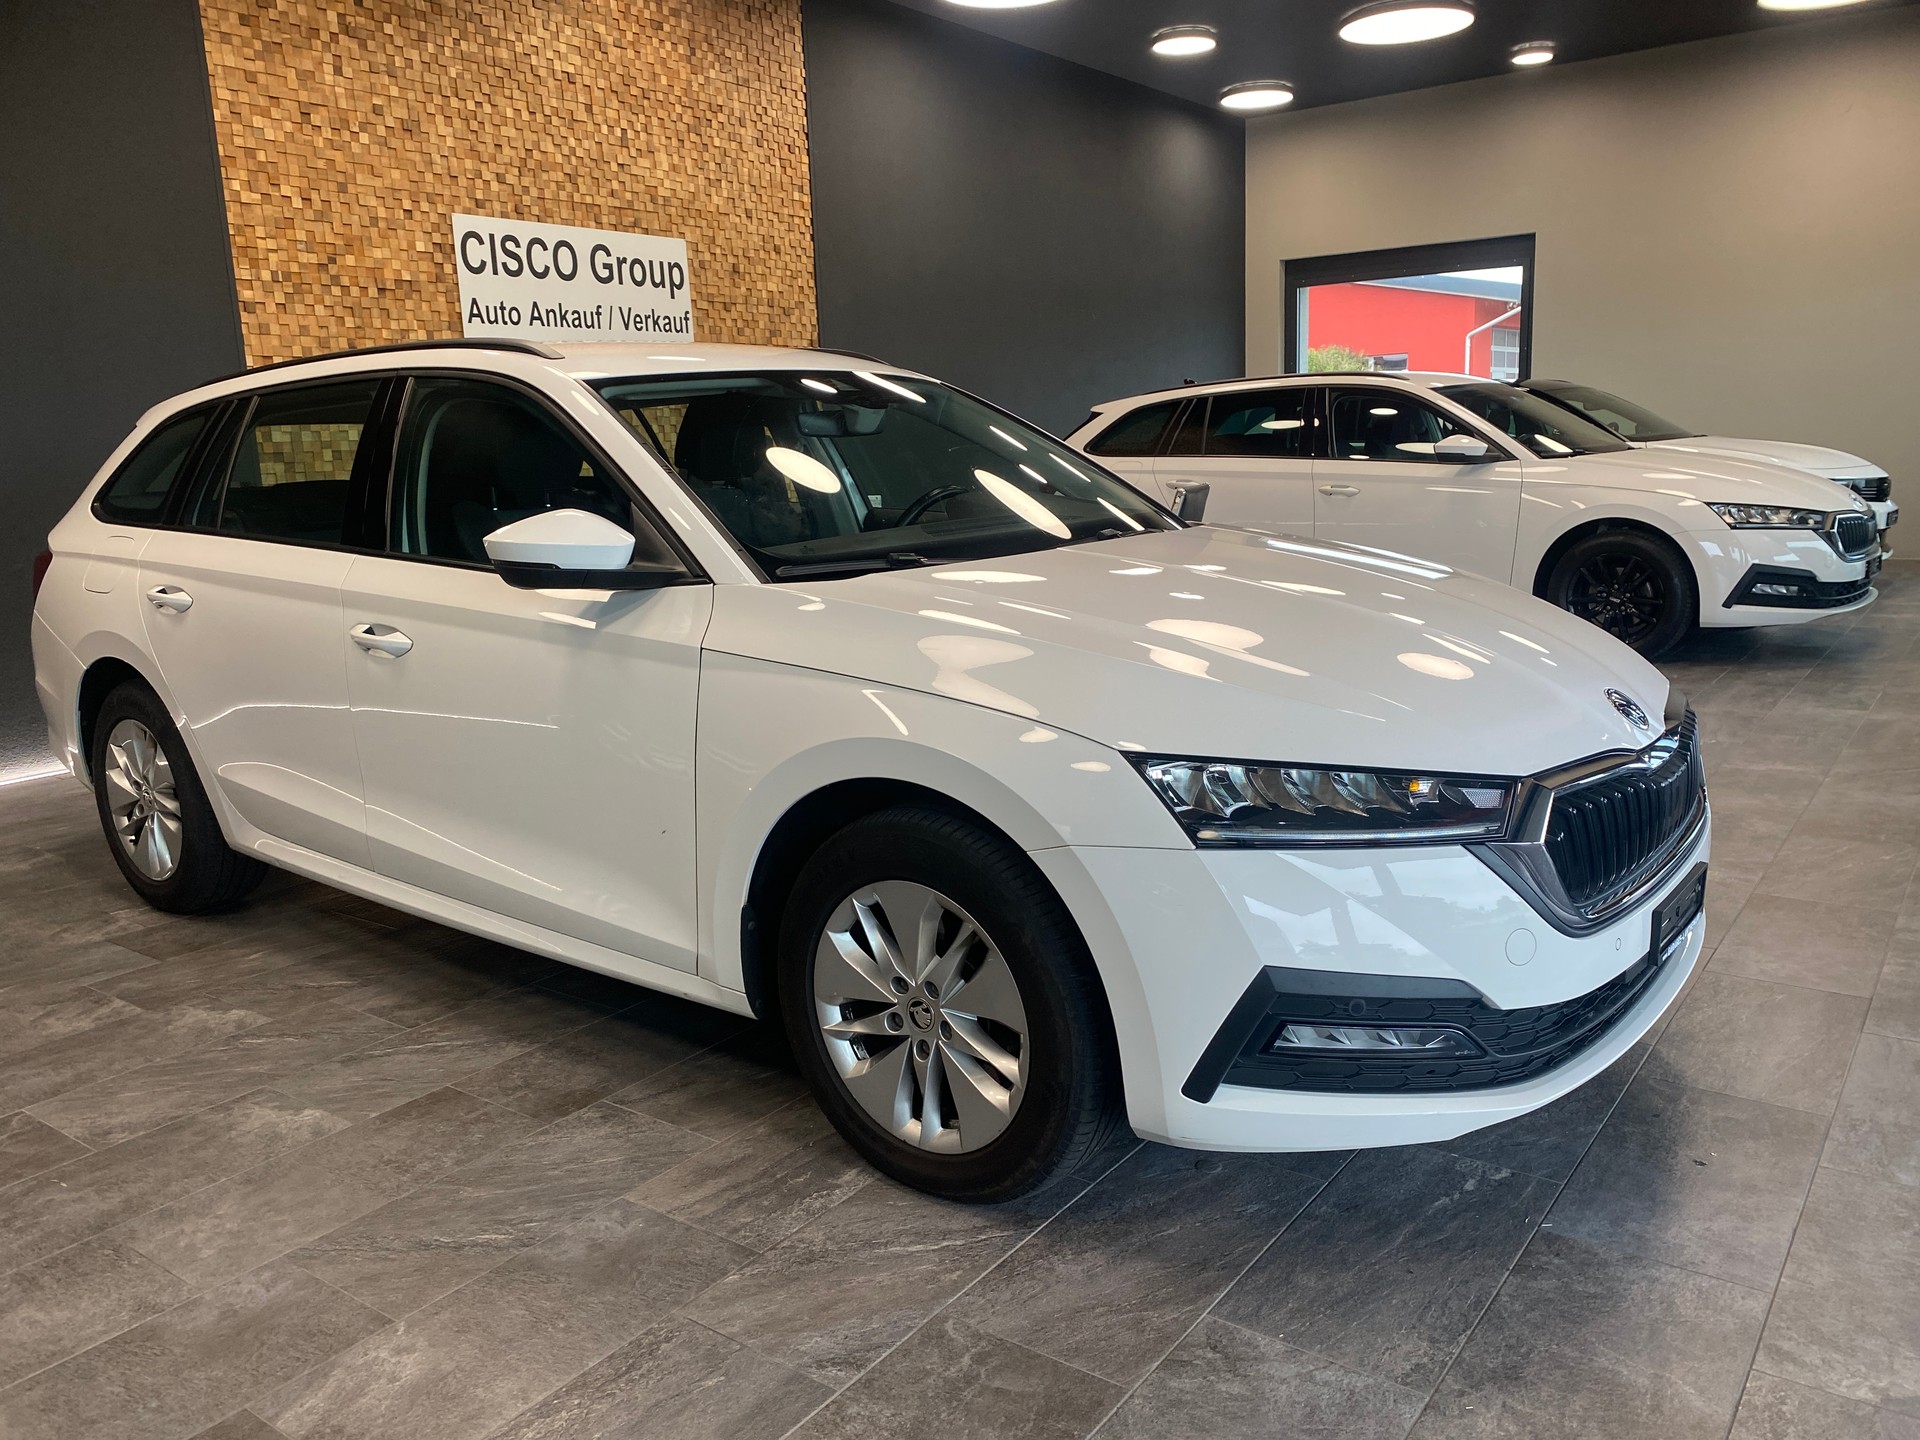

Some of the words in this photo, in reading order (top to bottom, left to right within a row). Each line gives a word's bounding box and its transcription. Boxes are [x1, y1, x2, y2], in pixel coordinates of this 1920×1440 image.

[460, 230, 578, 281] CISCO
[590, 243, 685, 299] Group
[468, 297, 521, 326] Auto
[529, 301, 602, 330] Ankauf
[618, 306, 690, 334] Verkauf
